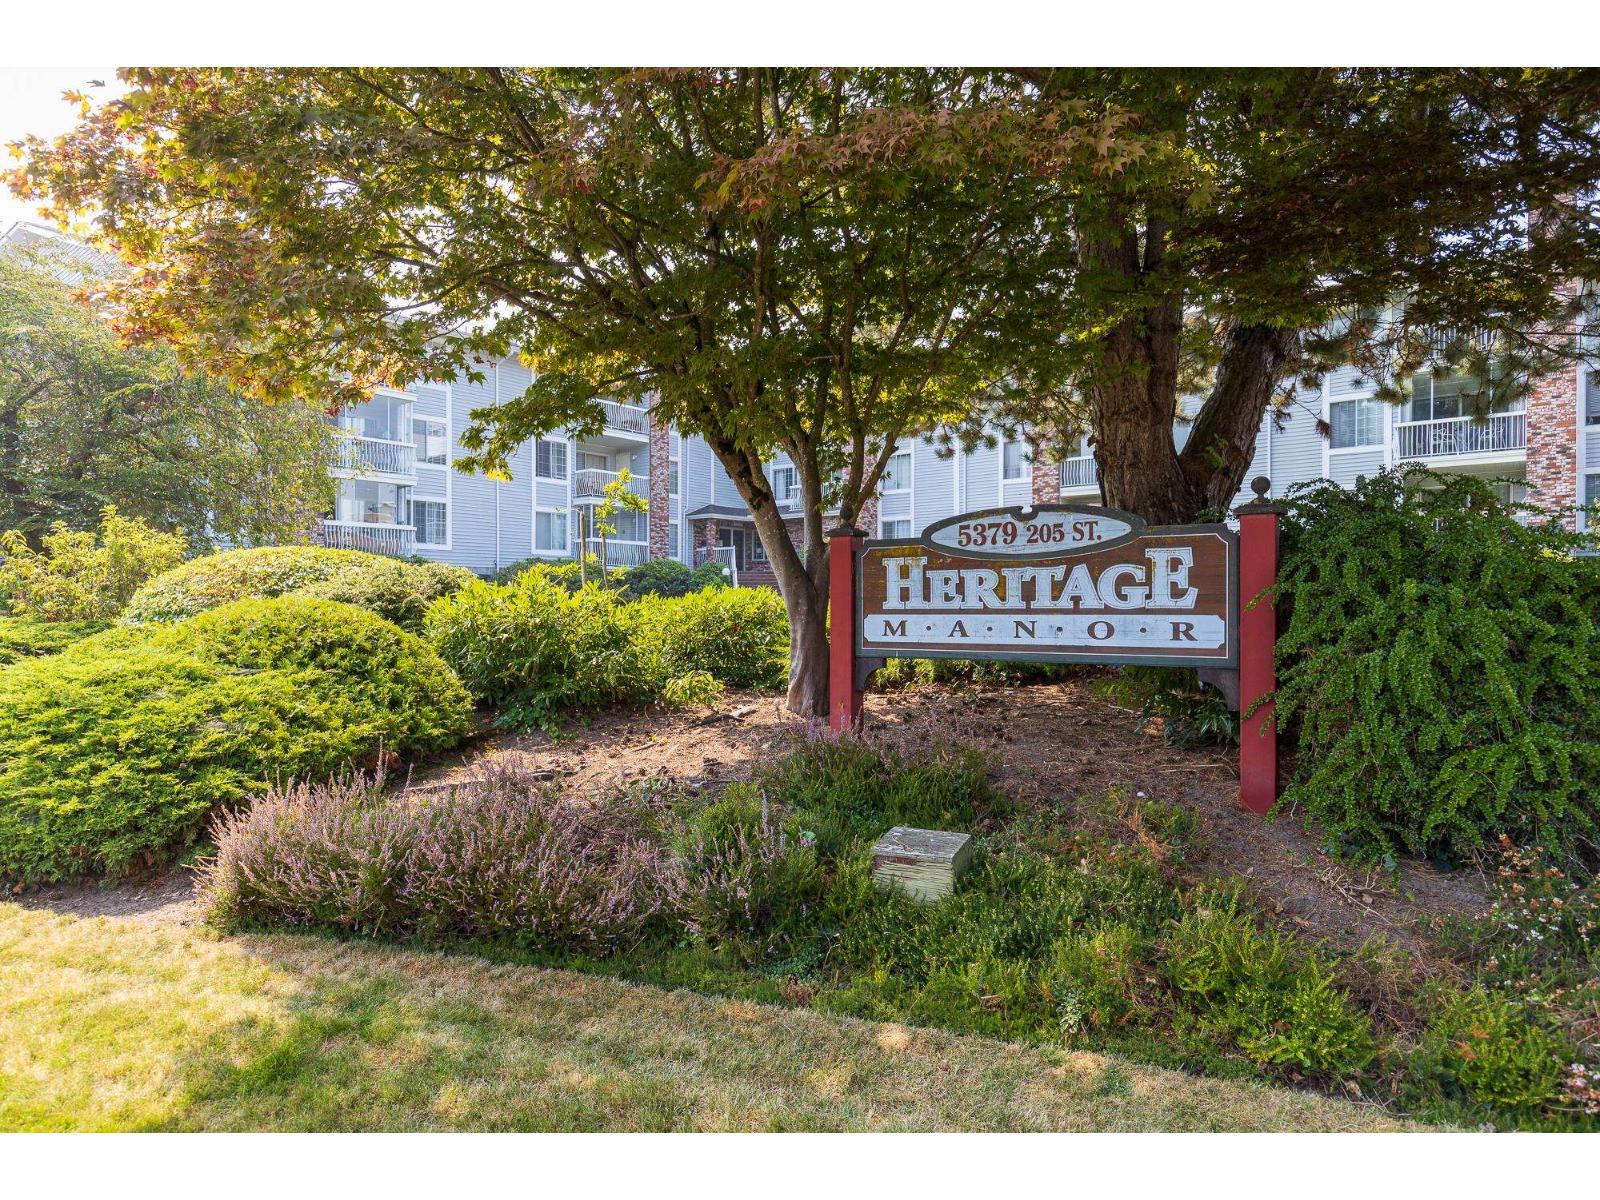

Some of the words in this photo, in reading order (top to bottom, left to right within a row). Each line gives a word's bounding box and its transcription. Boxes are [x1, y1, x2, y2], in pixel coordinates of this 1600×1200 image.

[958, 521, 1018, 547] 5379
[1026, 524, 1065, 544] 205
[1072, 520, 1102, 541] ST.
[882, 547, 1198, 610] HERITAGE
